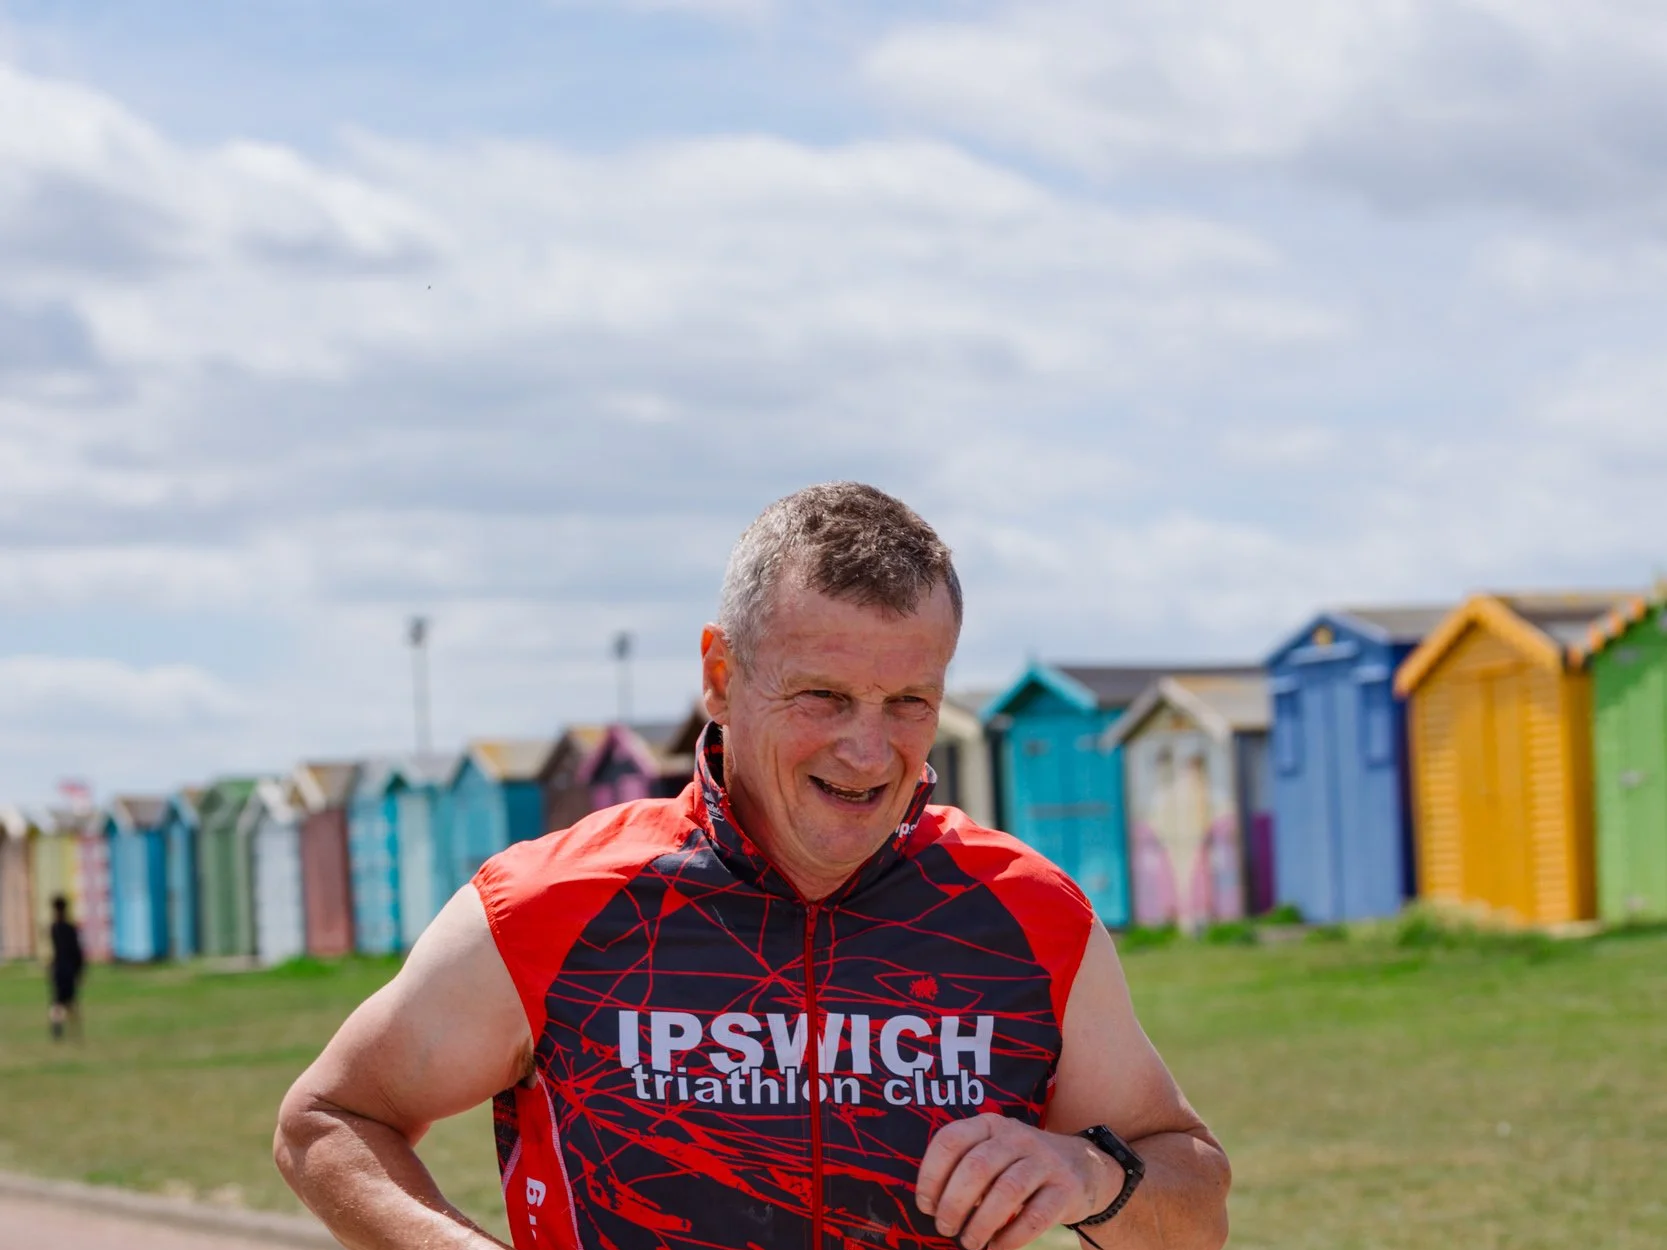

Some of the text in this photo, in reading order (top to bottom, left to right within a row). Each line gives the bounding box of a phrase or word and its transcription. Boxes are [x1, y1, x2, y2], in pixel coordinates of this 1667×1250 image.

[618, 1010, 994, 1075] IPSWICH
[631, 1064, 985, 1106] triathlon club
